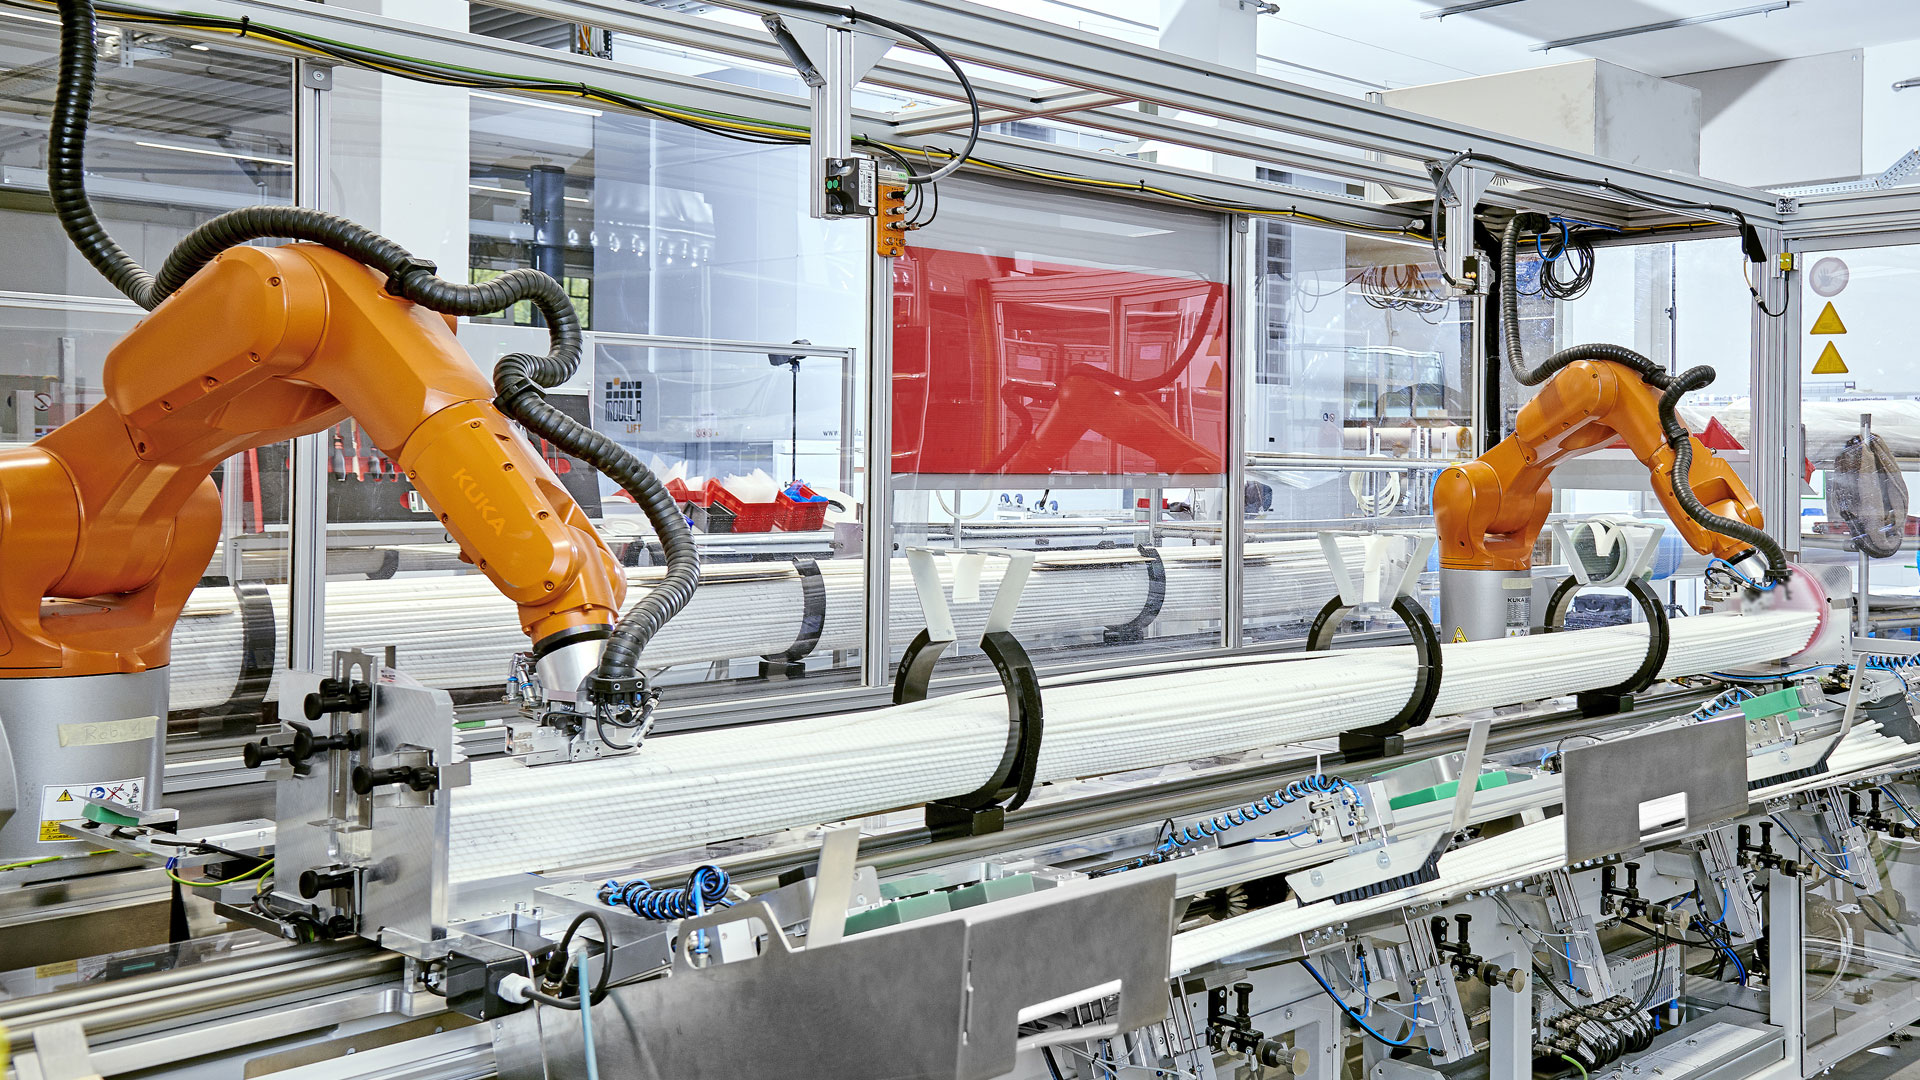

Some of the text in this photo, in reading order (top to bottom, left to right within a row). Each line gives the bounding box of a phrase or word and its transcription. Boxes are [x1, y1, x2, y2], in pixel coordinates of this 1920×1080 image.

[605, 400, 641, 421] MODULA
[626, 424, 641, 433] LIFT
[452, 468, 505, 536] KUKA
